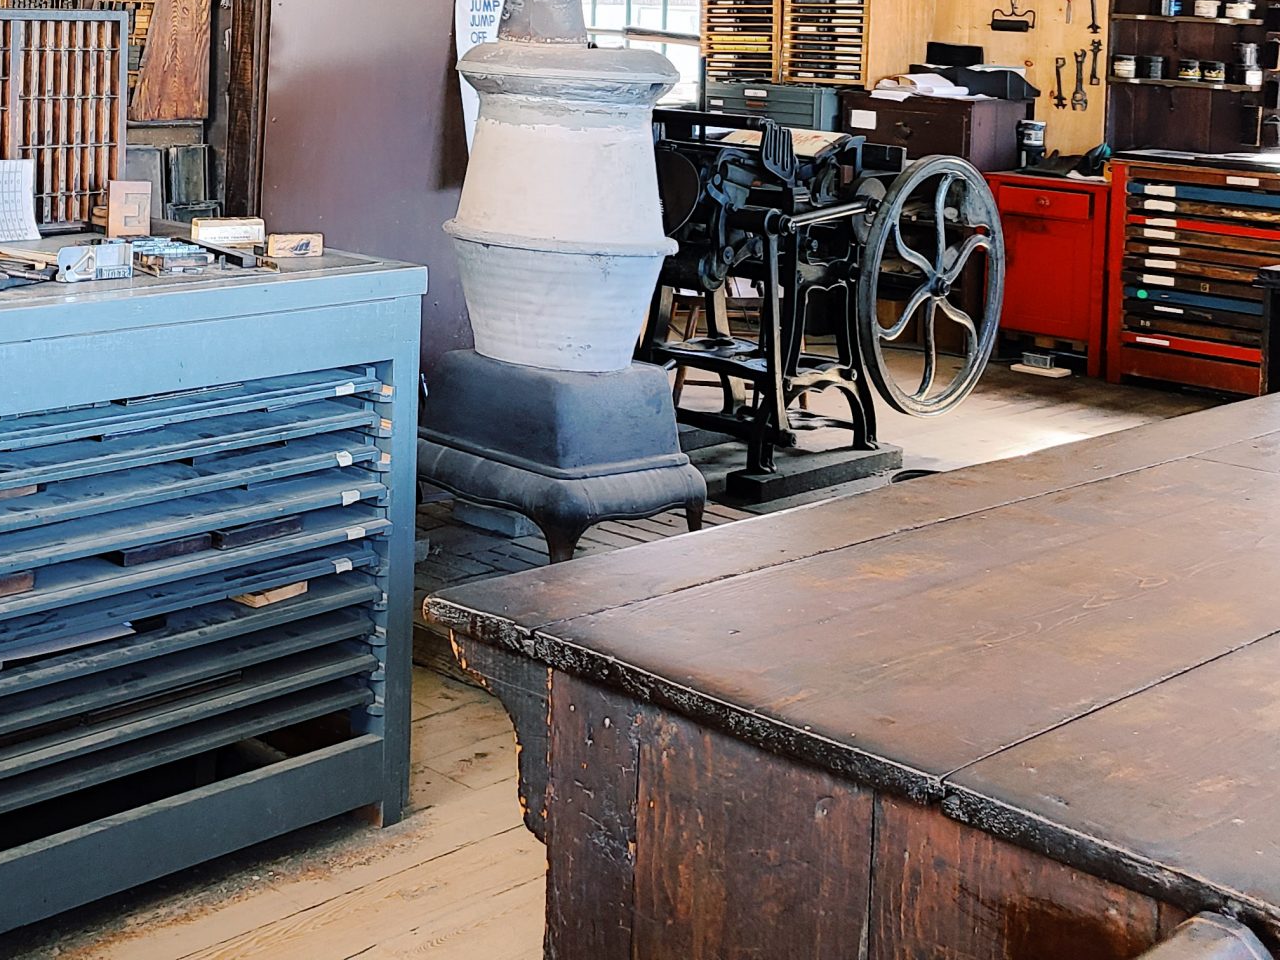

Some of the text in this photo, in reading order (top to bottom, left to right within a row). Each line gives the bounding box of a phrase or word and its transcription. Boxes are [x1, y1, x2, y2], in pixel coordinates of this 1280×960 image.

[469, 0, 500, 13] JUMP
[469, 14, 496, 27] JUMP
[470, 31, 488, 44] OFF
